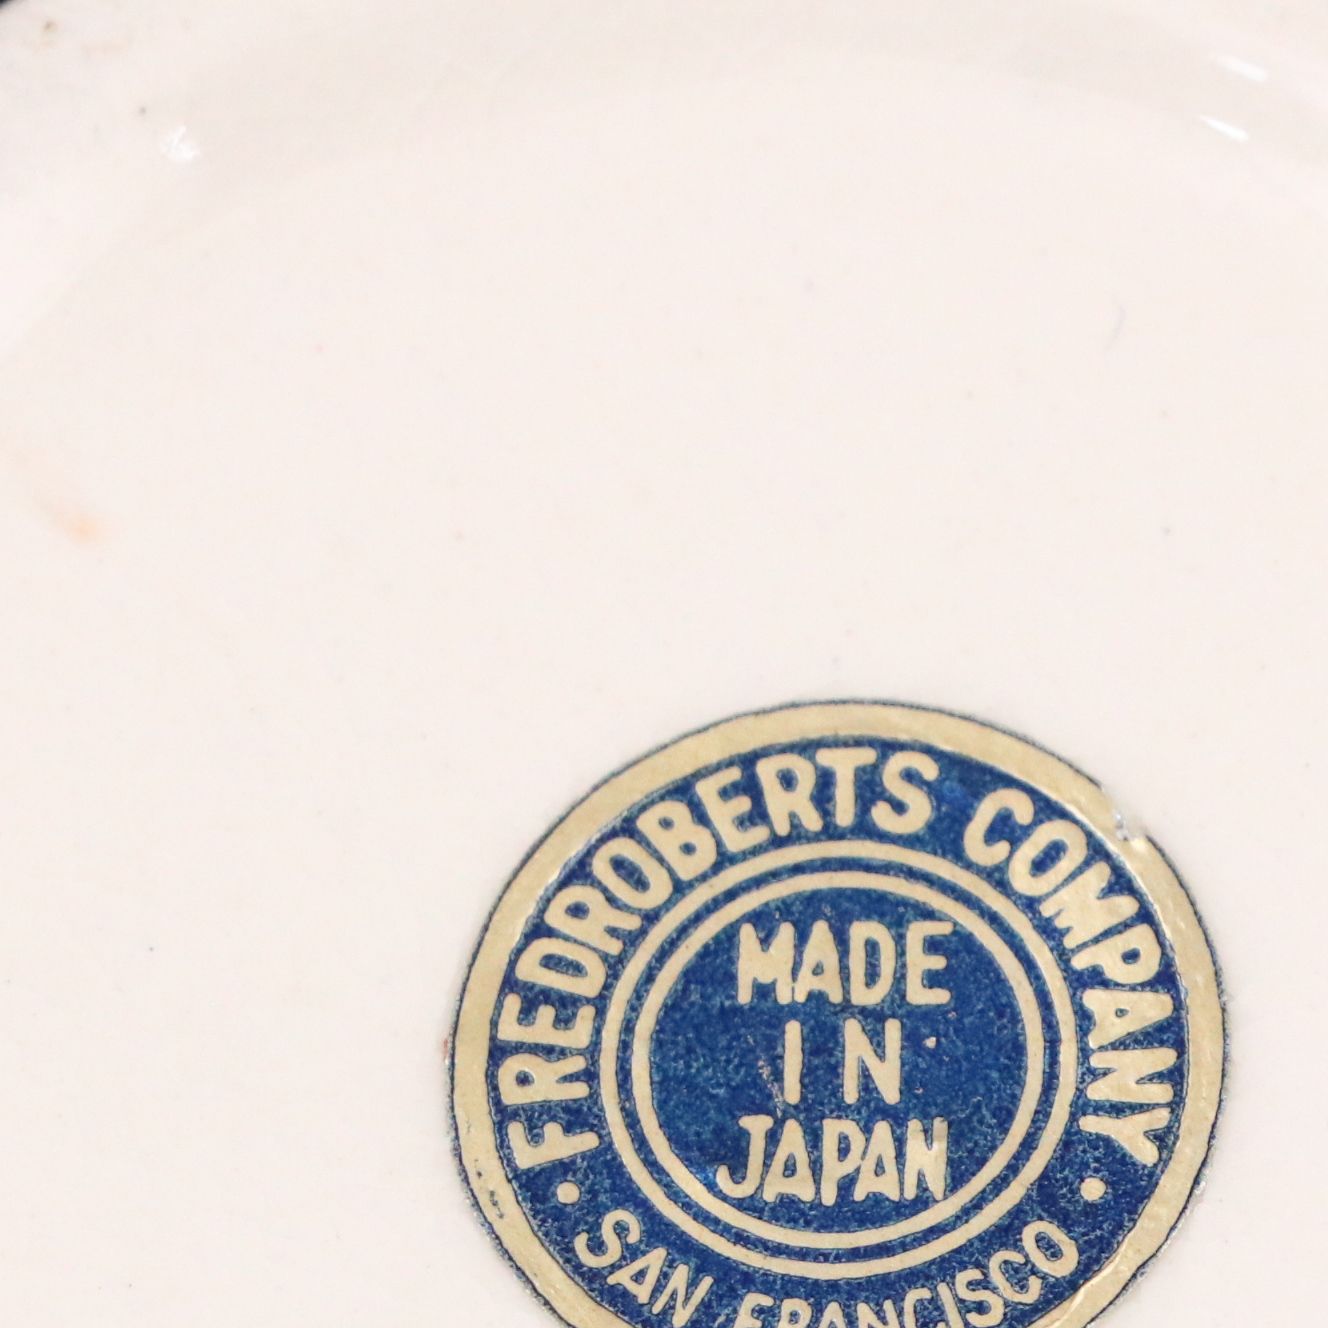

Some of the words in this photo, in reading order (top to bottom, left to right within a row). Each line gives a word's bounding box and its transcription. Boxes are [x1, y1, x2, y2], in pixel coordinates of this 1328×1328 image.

[737, 919, 954, 1006] MADE
[964, 788, 1188, 1166] COMPANY
[783, 1018, 901, 1105] IN
[715, 1114, 948, 1206] JAPAN
